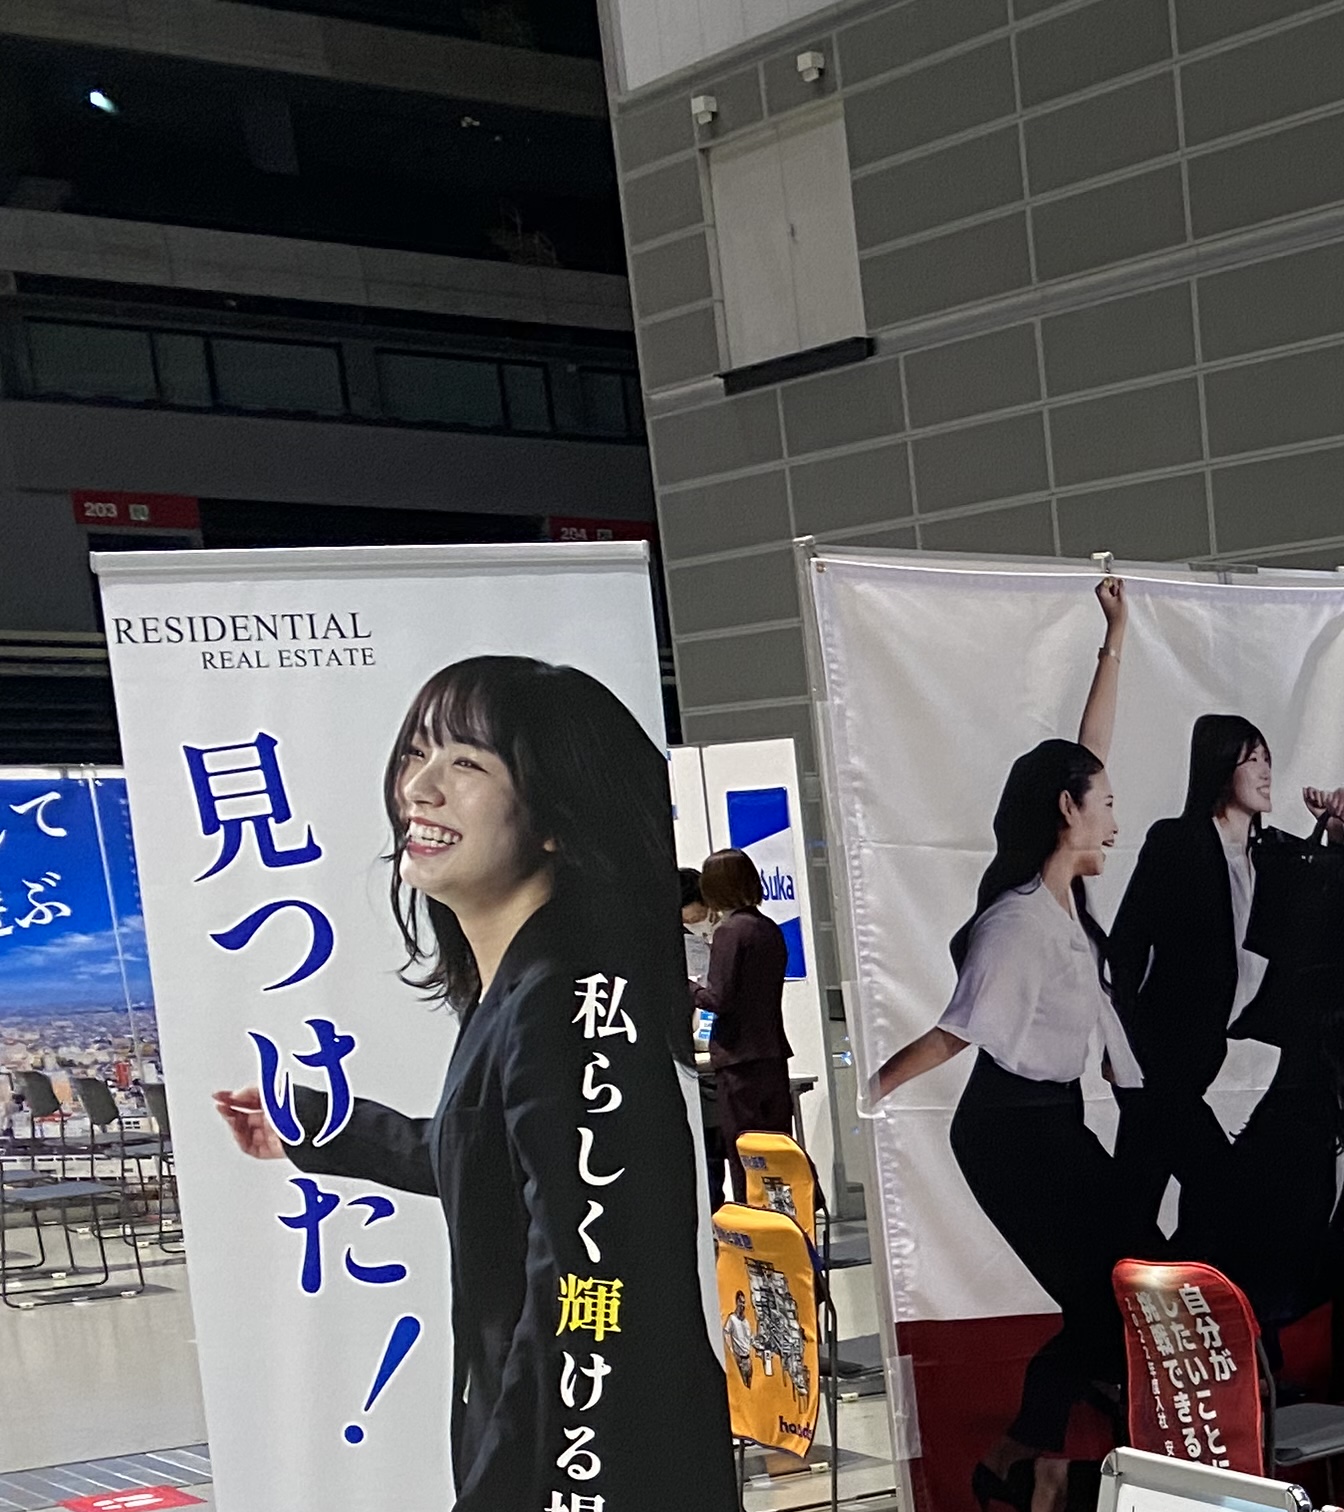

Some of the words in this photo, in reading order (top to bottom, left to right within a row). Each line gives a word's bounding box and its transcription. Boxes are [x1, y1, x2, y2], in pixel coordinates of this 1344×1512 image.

[112, 612, 373, 645] RESIDENTIAL
[201, 648, 270, 670] REAL
[278, 646, 377, 669] ESTATE
[182, 731, 421, 1445] 見つけた！
[1157, 1290, 1230, 1471] したいこと
[1178, 1283, 1238, 1382] 自分が
